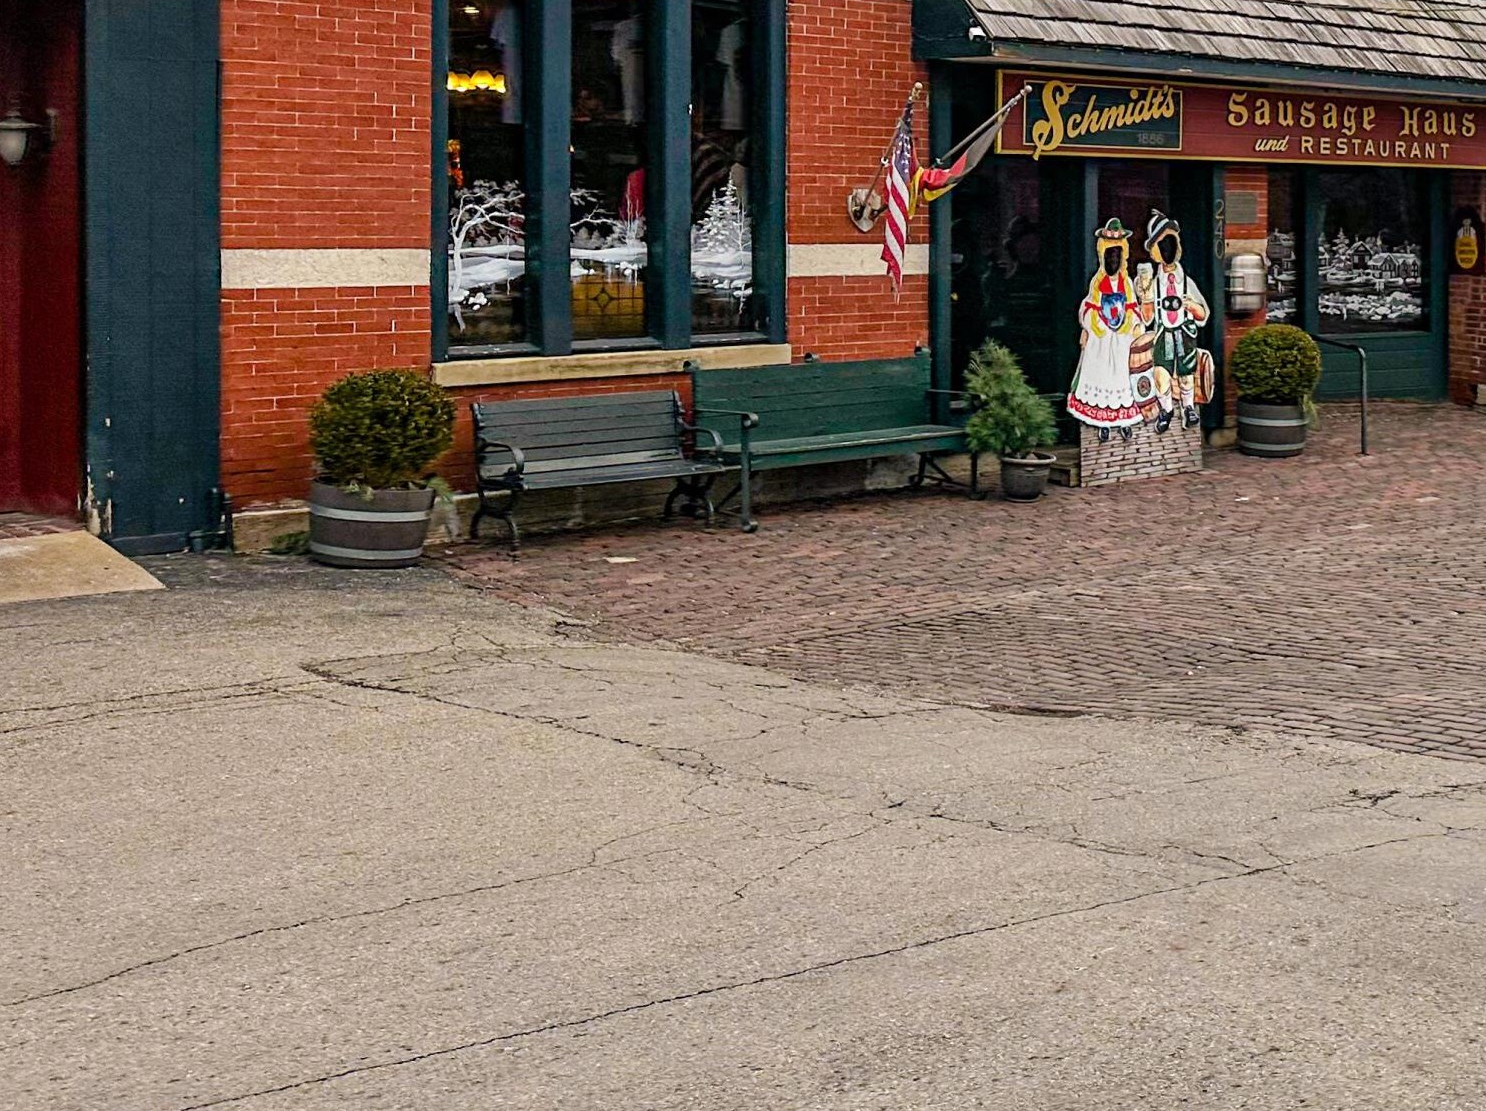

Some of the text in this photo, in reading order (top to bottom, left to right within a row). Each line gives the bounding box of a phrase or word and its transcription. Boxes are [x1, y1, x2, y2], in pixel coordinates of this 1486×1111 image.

[1032, 80, 1175, 161] Schmidt's
[1227, 91, 1476, 137] Sausage Haus
[1254, 135, 1450, 159] und RESTAURANT
